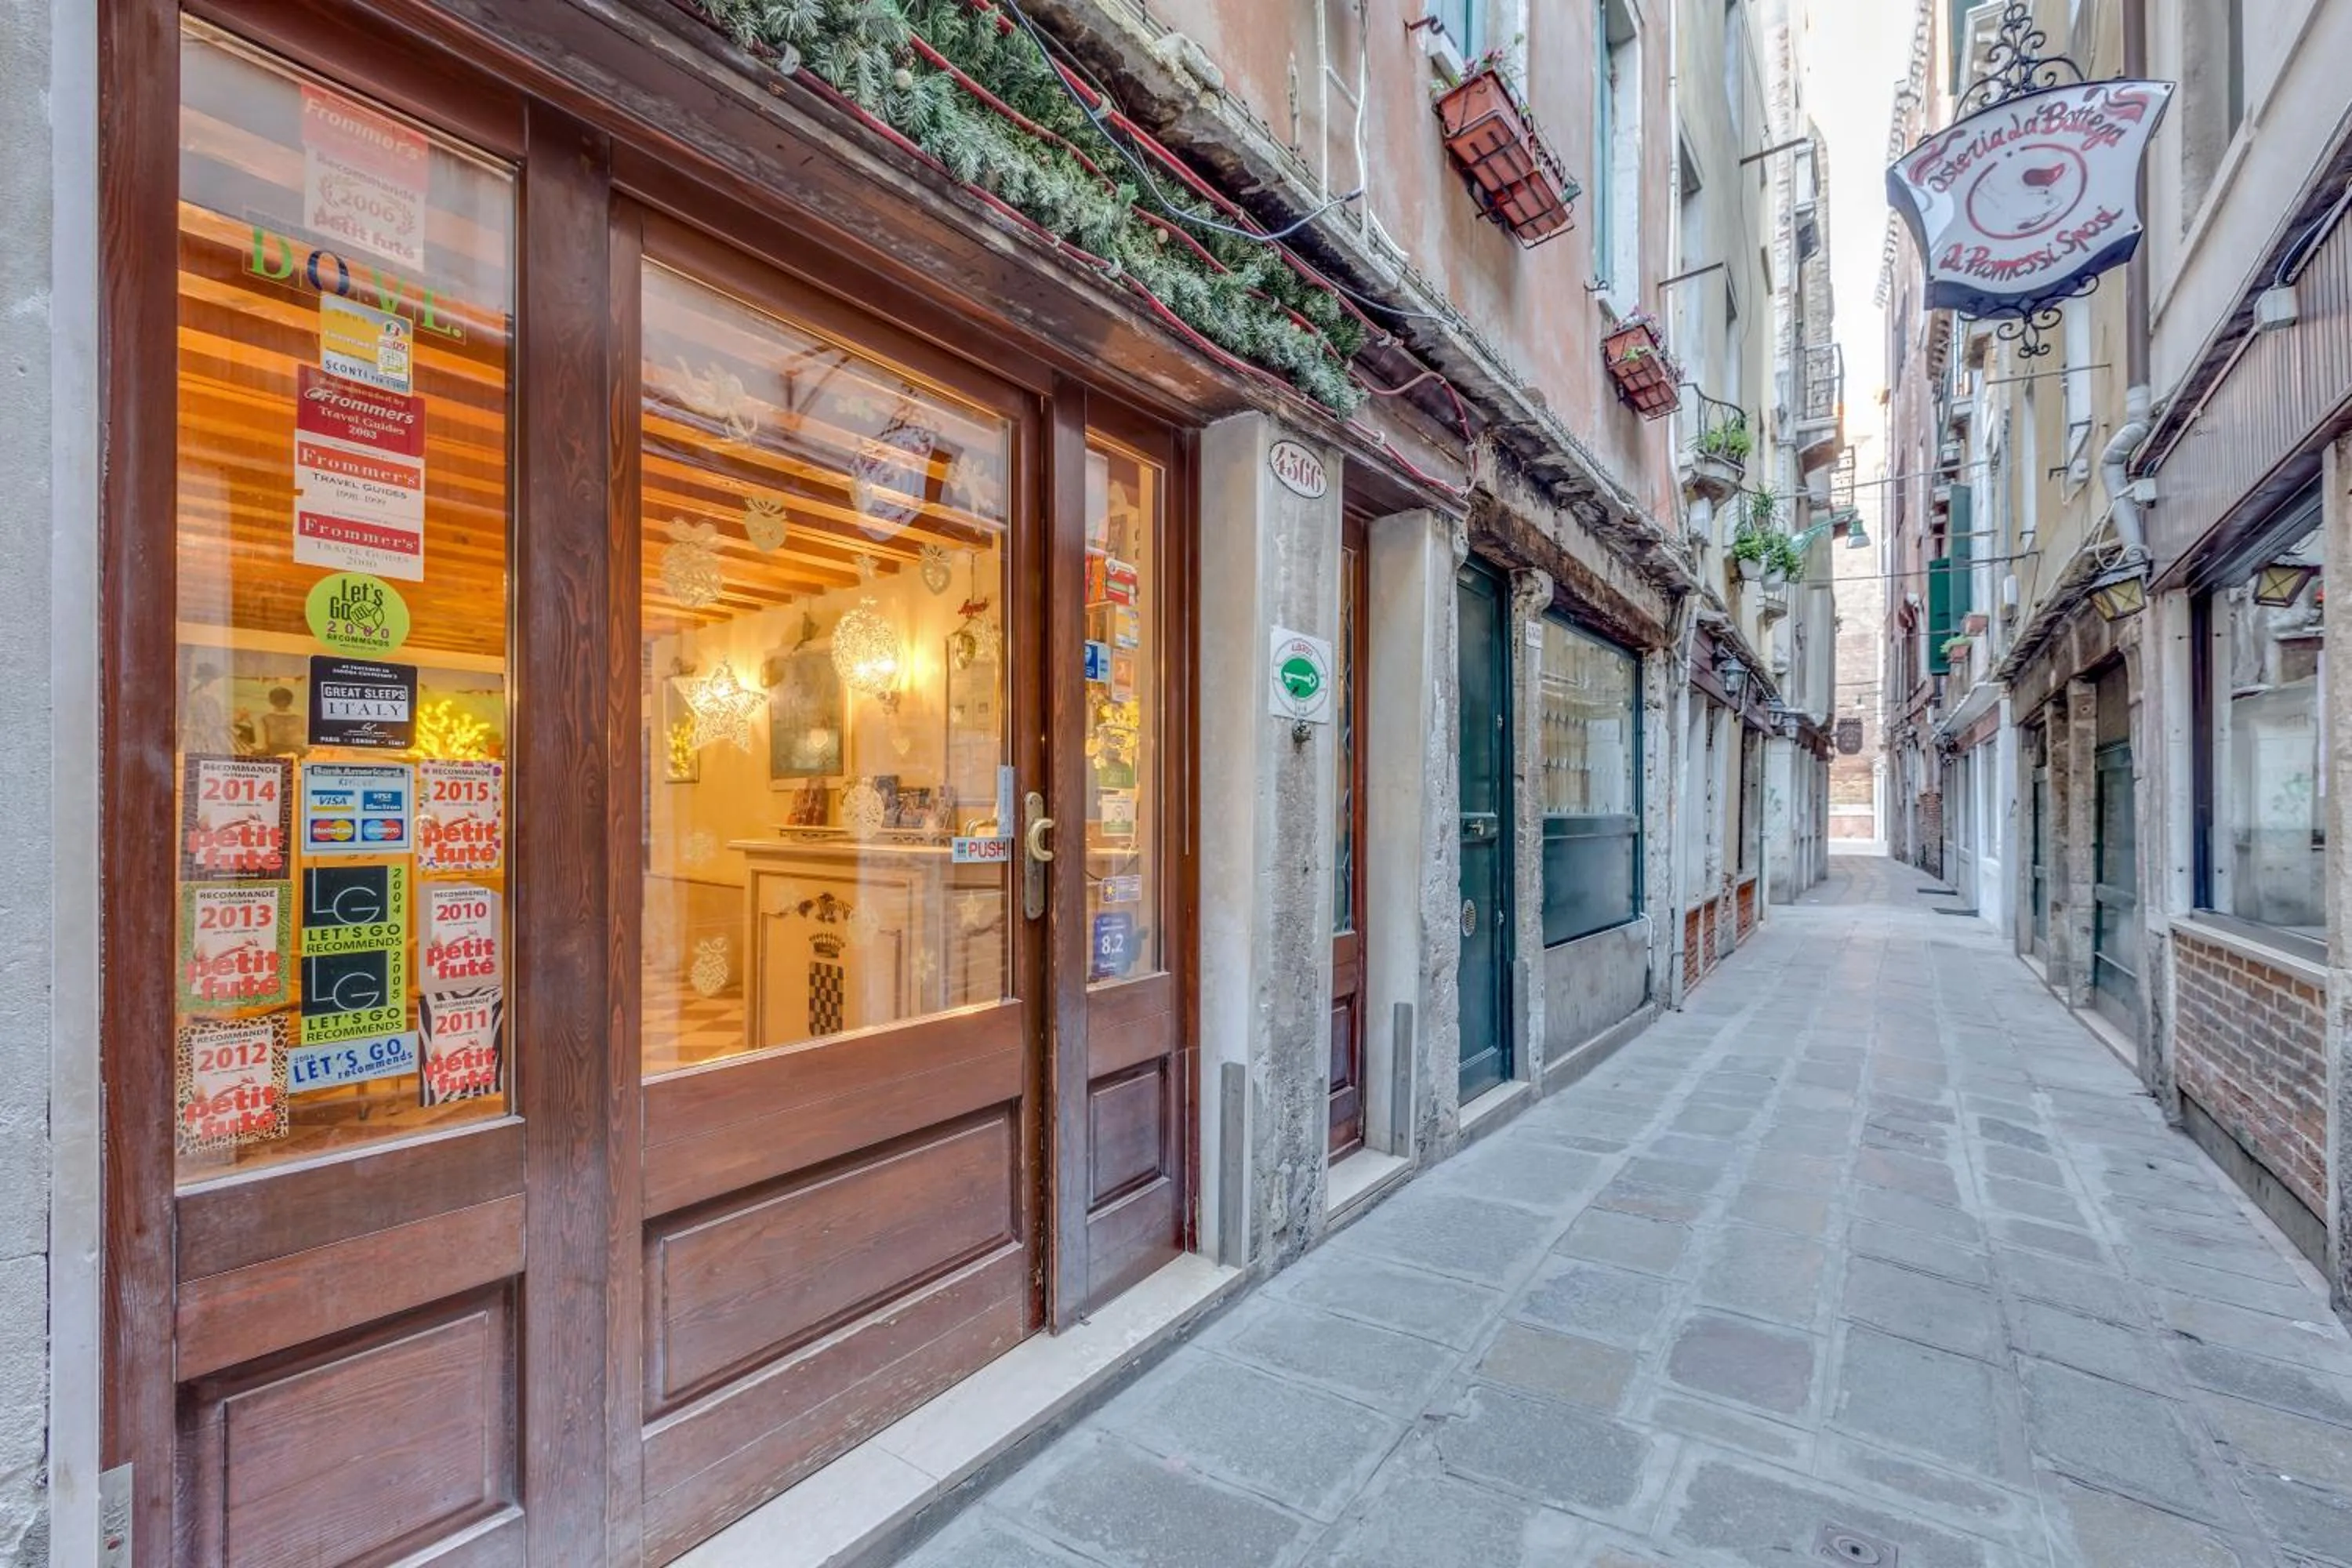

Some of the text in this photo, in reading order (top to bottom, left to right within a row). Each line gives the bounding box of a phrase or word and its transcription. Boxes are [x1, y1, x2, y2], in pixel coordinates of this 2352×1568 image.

[325, 359, 368, 378] SCONTI
[318, 405, 405, 436] Travel Guides
[301, 448, 416, 485] Frommer's
[313, 472, 408, 500] TRAVEL GUIDES
[303, 517, 415, 550] Frommer's
[342, 579, 383, 607] Let's
[326, 633, 390, 647] RECOMMENDS
[325, 686, 406, 700] GREAT SLEEPS
[329, 702, 402, 716] ITALY
[203, 777, 277, 802] 2014
[319, 796, 347, 805] VISA
[434, 781, 489, 801] 2015
[187, 824, 285, 854] petit
[423, 821, 496, 848] petit
[204, 848, 283, 871] futé
[435, 842, 496, 863] futé
[968, 840, 1006, 858] PUSH
[312, 867, 380, 925] LG
[199, 905, 273, 929] 2013
[437, 902, 487, 921] 2010
[307, 938, 402, 954] RECOMMENDS
[308, 924, 401, 942] LET'S GO
[426, 938, 495, 967] petit
[185, 949, 281, 983] petit
[437, 957, 495, 979] futé
[201, 974, 281, 1001] futé
[312, 956, 380, 1011] LG
[307, 1021, 402, 1042] RECOMMENDS
[308, 1007, 401, 1030] LET'S GO
[435, 1009, 487, 1034] 2011
[198, 1042, 267, 1072] 2012
[293, 1050, 358, 1083] LET'S
[369, 1038, 401, 1061] GO
[338, 1051, 413, 1079] recommends
[426, 1047, 496, 1082] petit
[437, 1068, 495, 1094] futé
[185, 1086, 277, 1126] petit
[200, 1109, 277, 1141] futé
